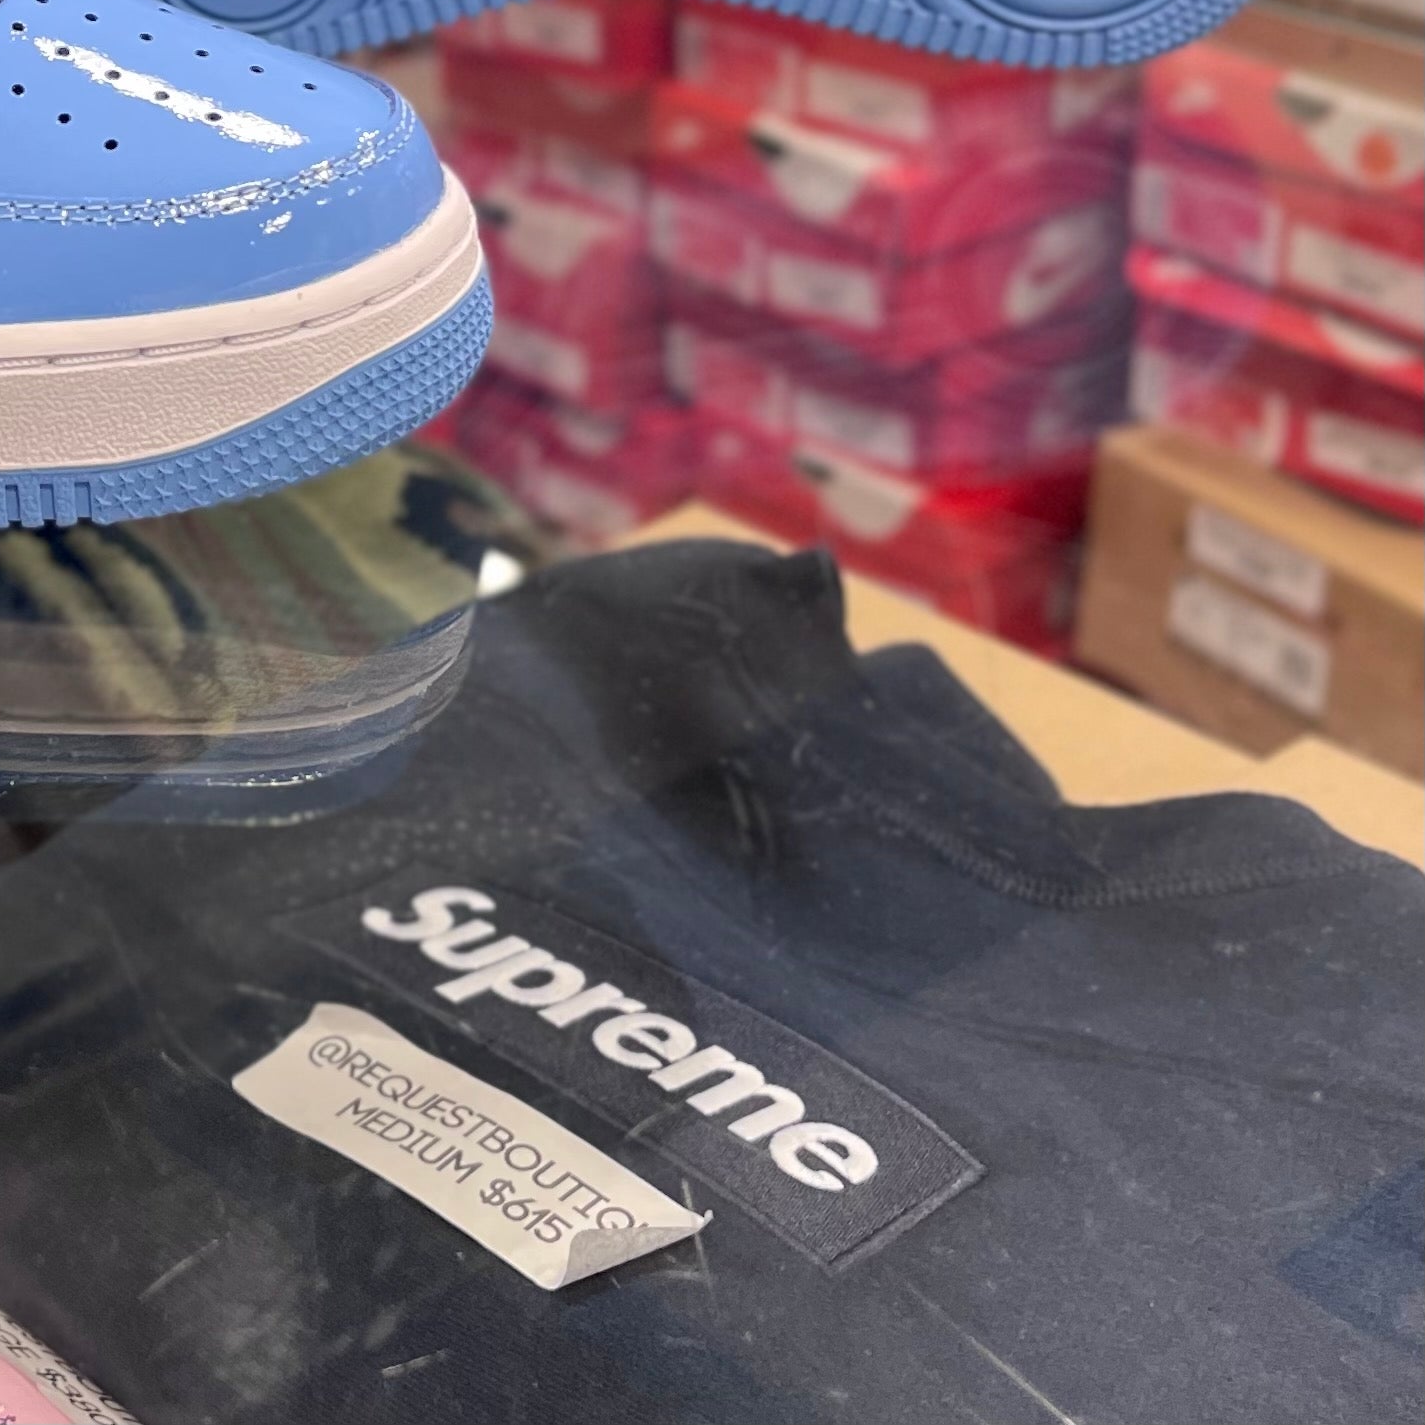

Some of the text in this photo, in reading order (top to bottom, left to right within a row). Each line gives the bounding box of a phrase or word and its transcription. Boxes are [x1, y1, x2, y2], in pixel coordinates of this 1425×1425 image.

[308, 1034, 650, 1229] @REQUESTBOUTIQ
[362, 886, 879, 1190] Supreme
[336, 1098, 573, 1243] MEDIUM $615
